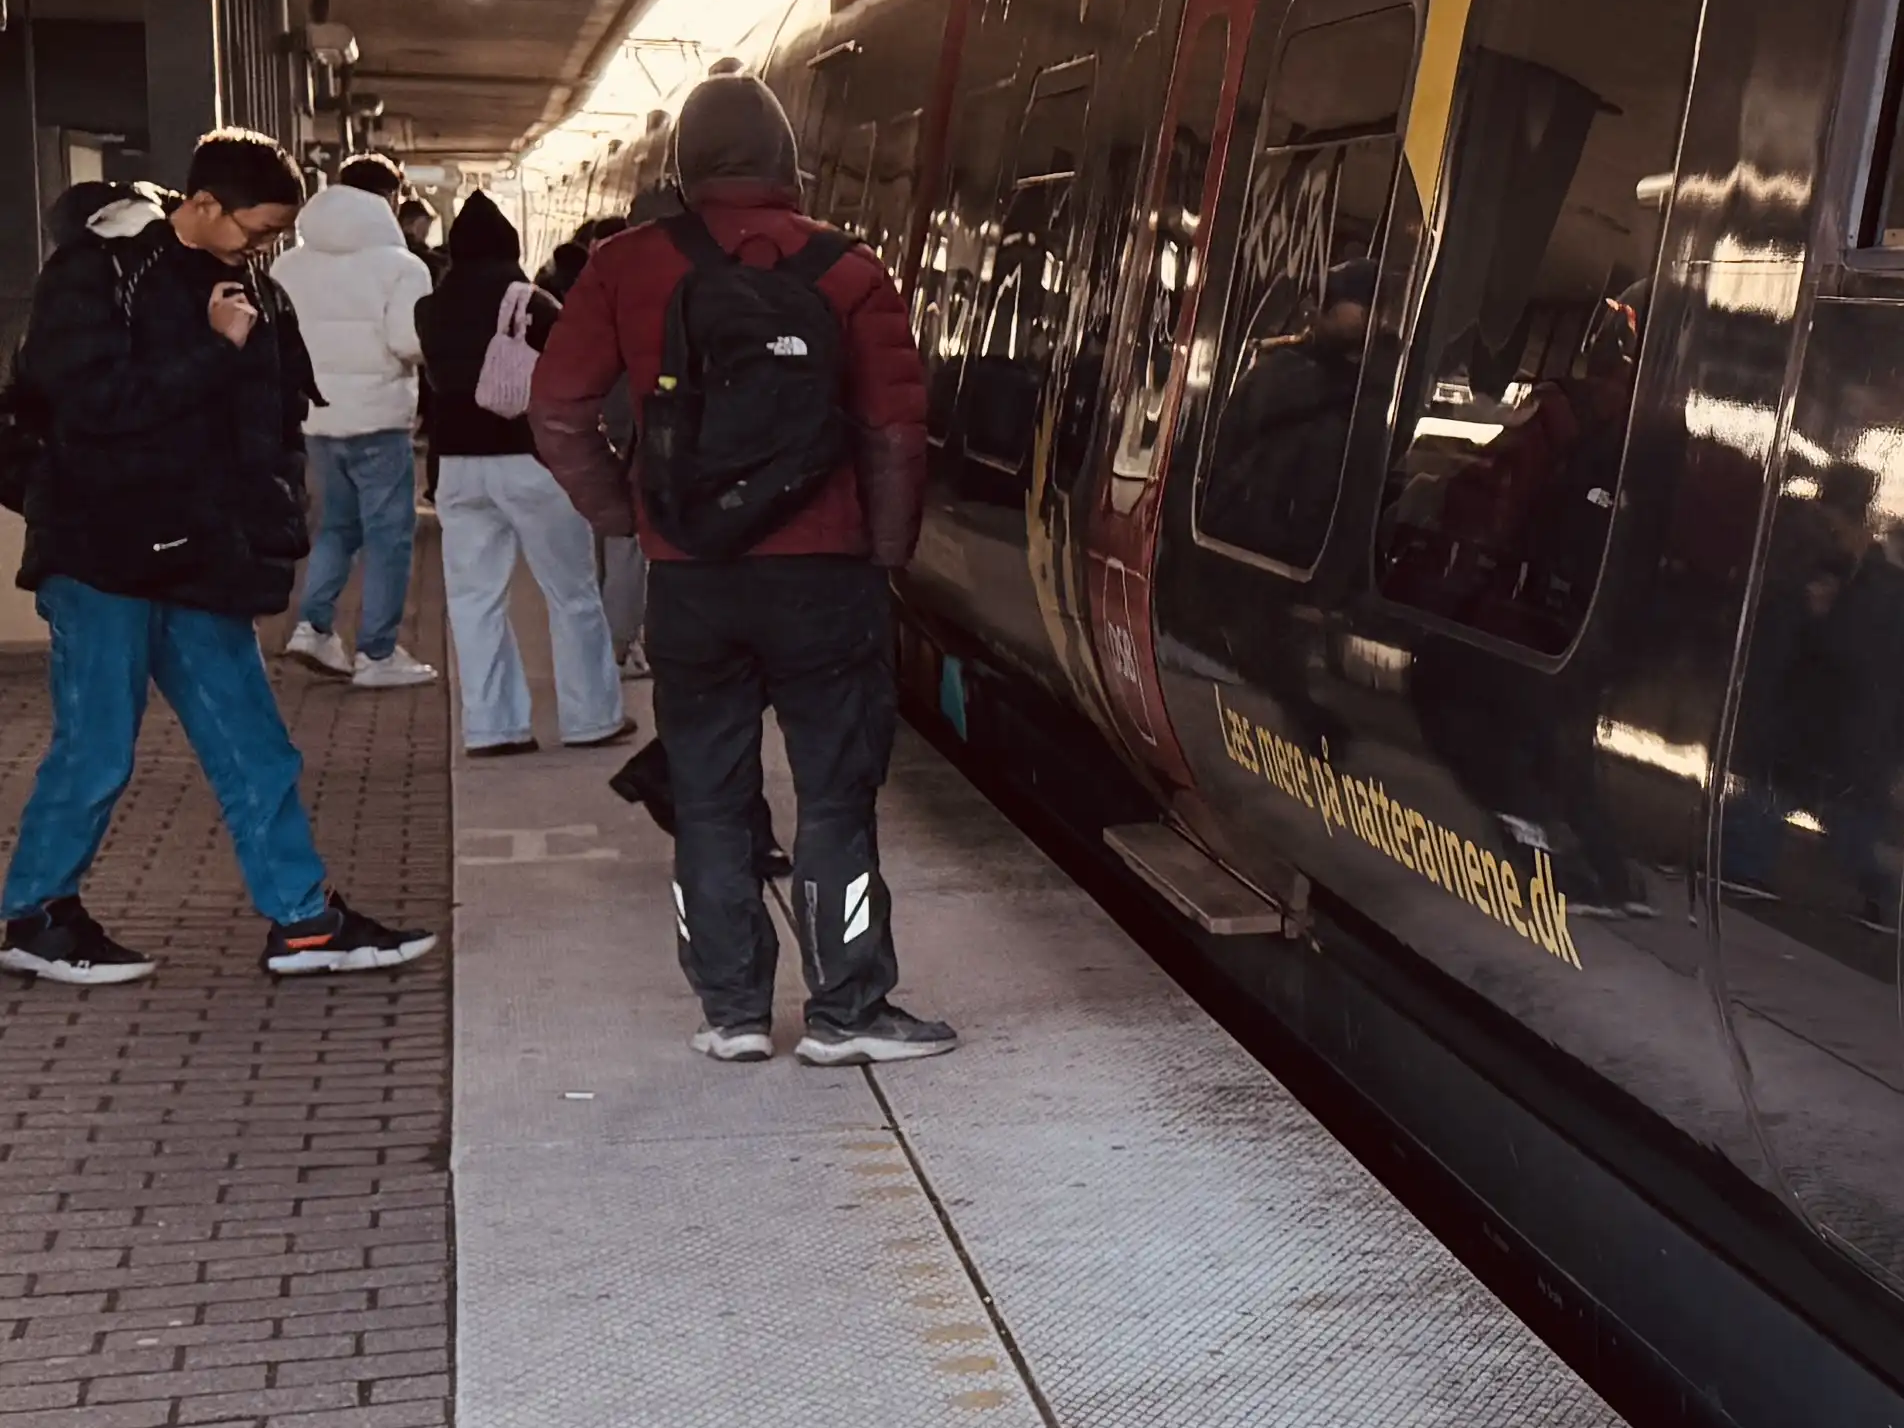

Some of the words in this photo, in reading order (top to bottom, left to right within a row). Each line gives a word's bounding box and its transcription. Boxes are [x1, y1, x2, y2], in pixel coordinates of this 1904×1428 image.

[1214, 682, 1260, 775] Læs
[1255, 724, 1314, 809] mere
[1310, 734, 1347, 838] på
[1340, 773, 1583, 971] natteravnene.dk
